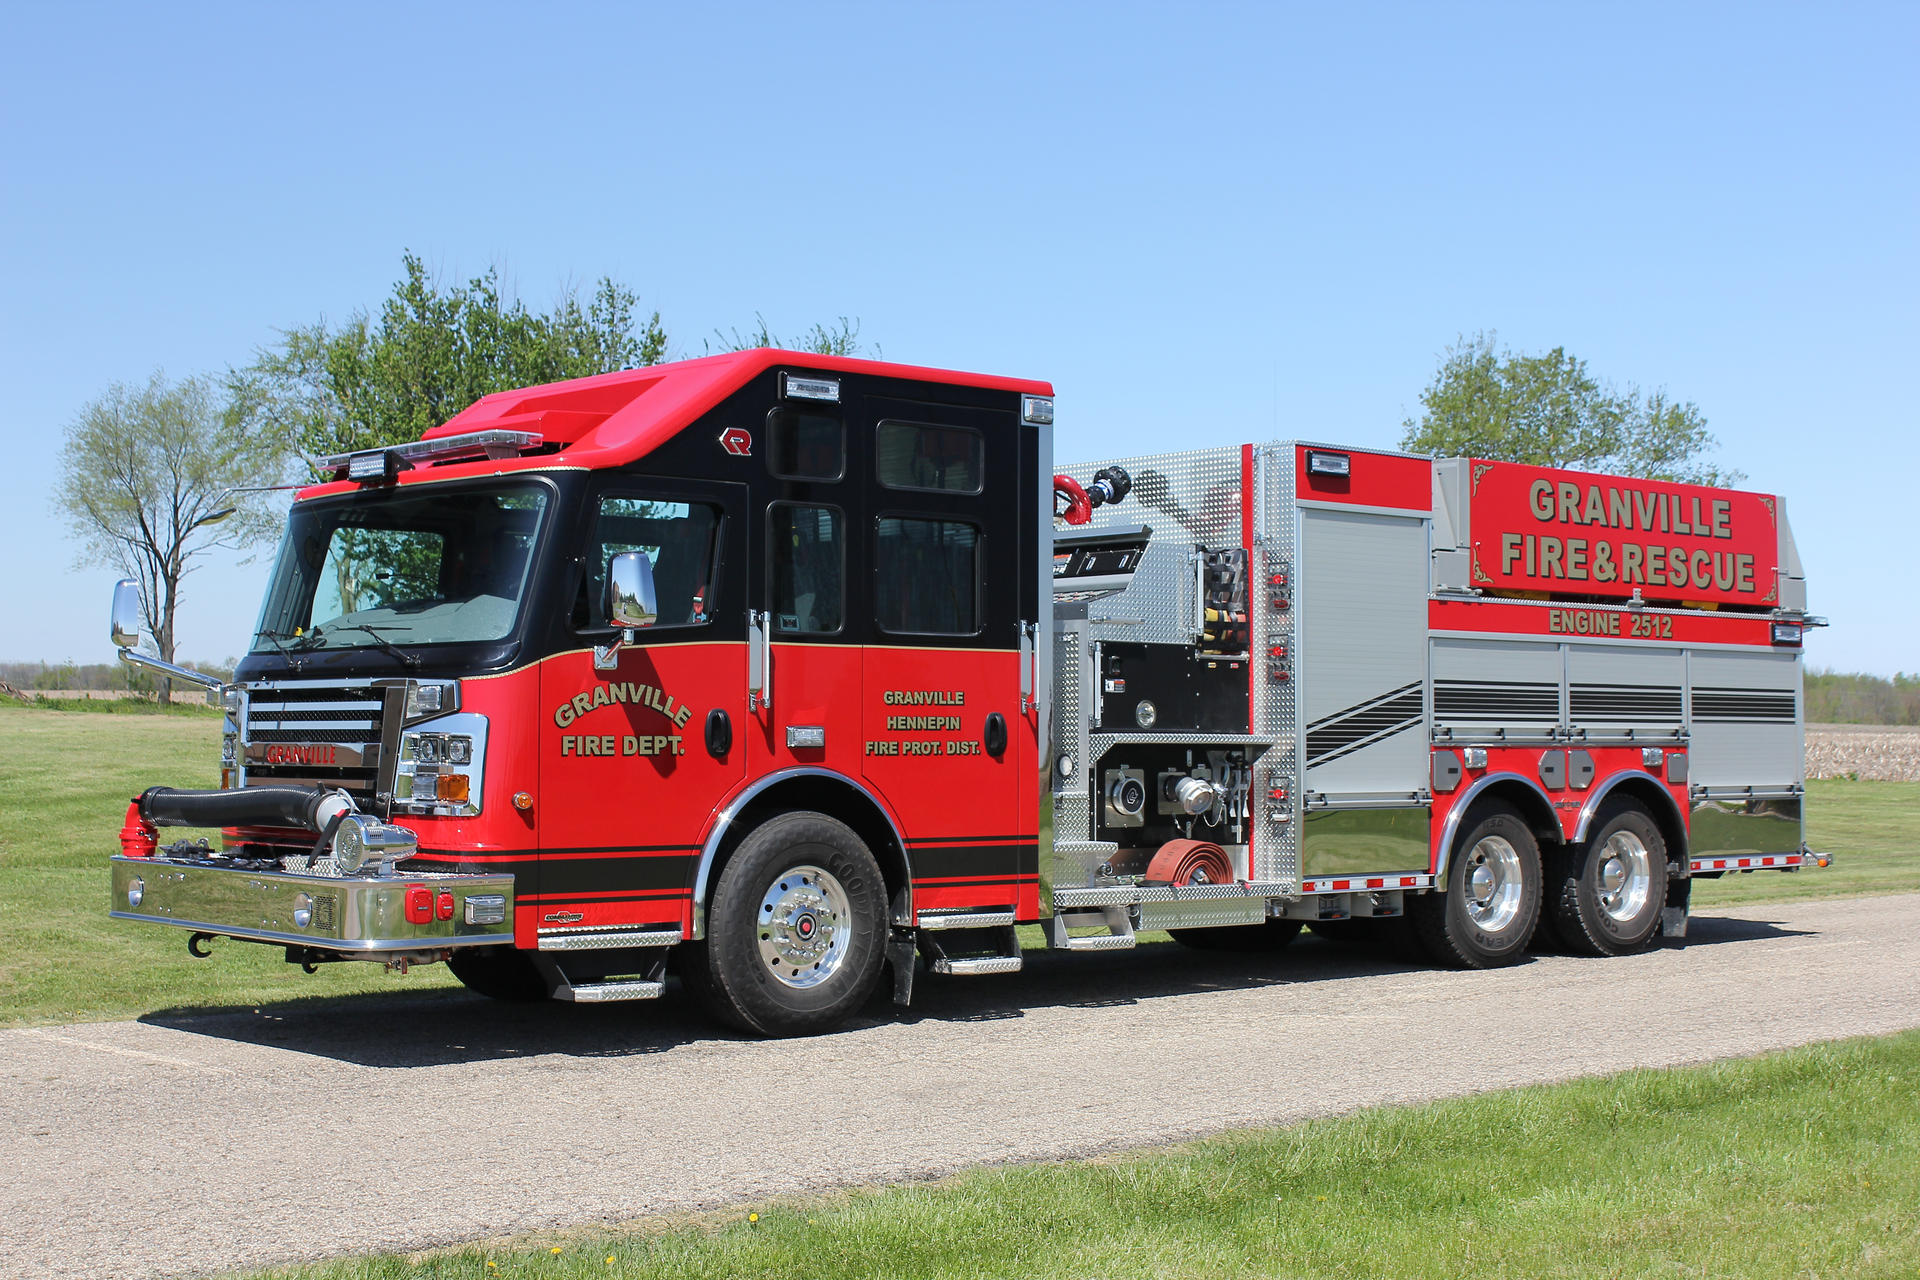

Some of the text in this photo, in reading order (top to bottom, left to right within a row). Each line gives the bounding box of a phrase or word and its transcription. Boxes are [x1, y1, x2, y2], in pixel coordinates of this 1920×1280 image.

[1529, 479, 1732, 539] GRANVILLE
[1549, 609, 1673, 638] ENGINE 2512
[554, 682, 692, 729] GRANVILLE
[883, 690, 965, 706] GRANVILLE
[887, 715, 961, 731] HENNEPIN
[267, 745, 336, 764] GRANVILLE
[562, 735, 685, 757] FIRE DEPT.
[865, 741, 981, 756] FIRE PROT. DIST.
[828, 852, 873, 998] GOODYEAR
